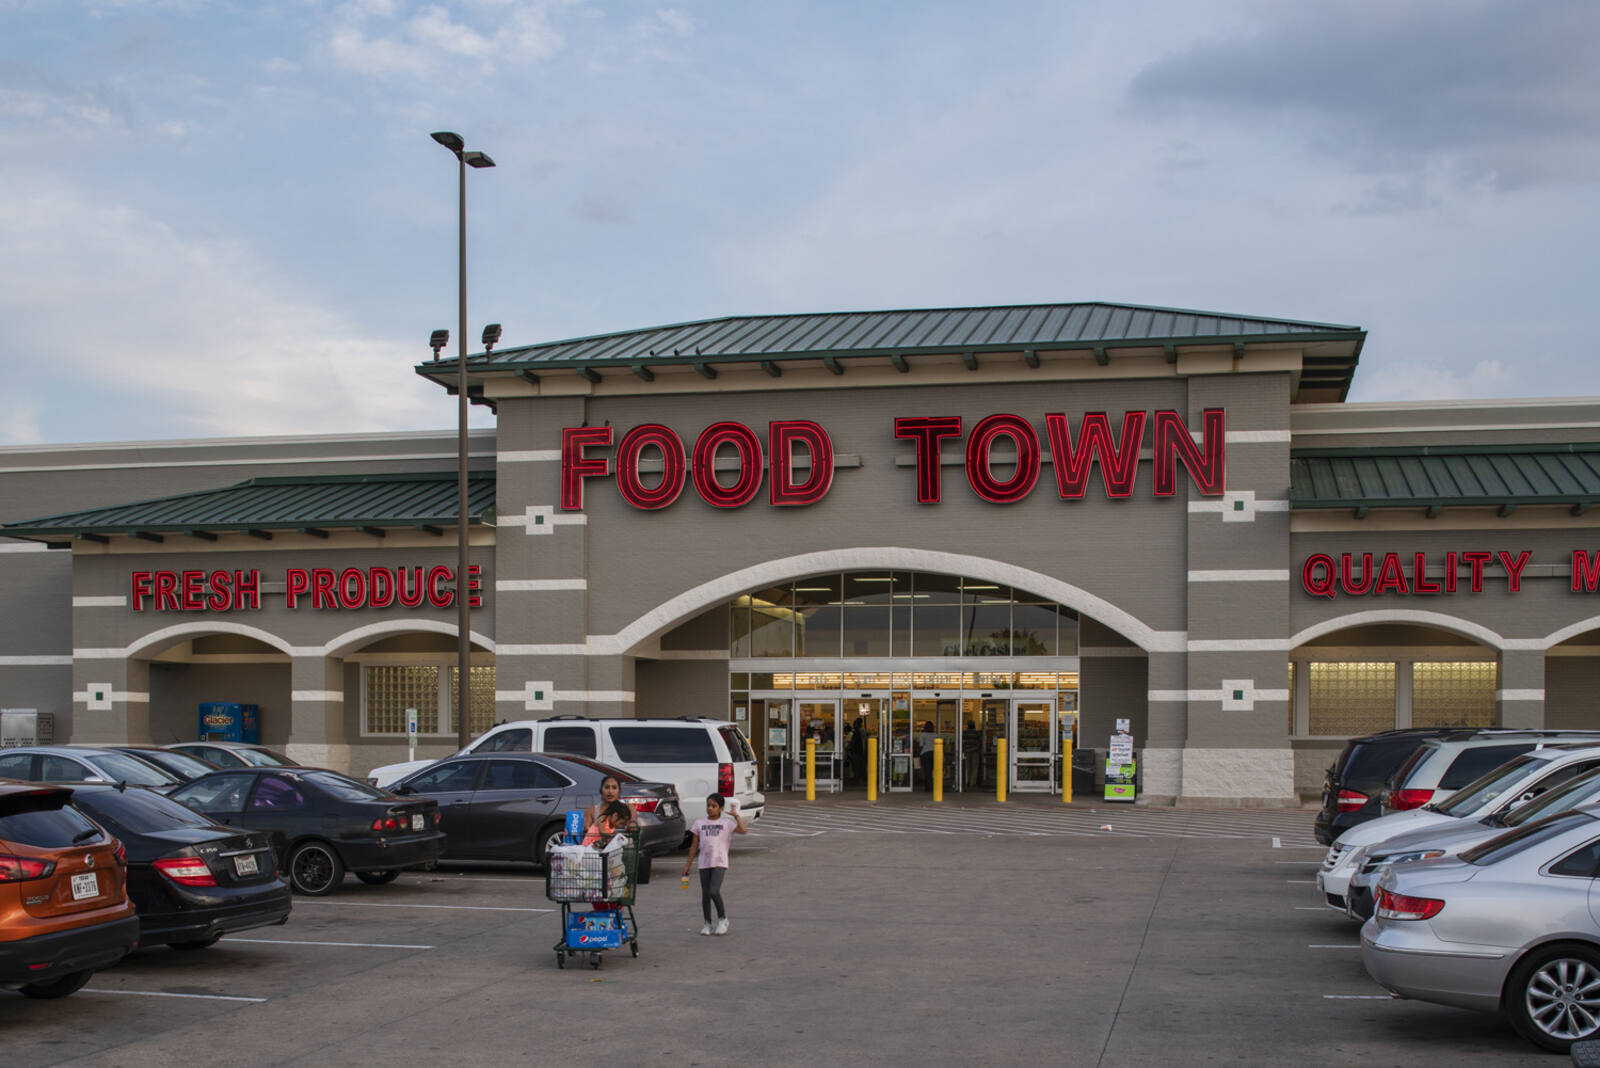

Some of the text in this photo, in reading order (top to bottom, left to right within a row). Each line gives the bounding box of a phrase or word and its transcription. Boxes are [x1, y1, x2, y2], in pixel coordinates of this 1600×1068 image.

[560, 407, 1225, 510] FOOD TOWN
[131, 565, 482, 611] FRESH PRODUCE
[1302, 550, 1600, 599] QUALITY M
[980, 644, 1027, 656] Cashng
[203, 714, 233, 725] Glacier
[589, 935, 608, 943] pepsi
